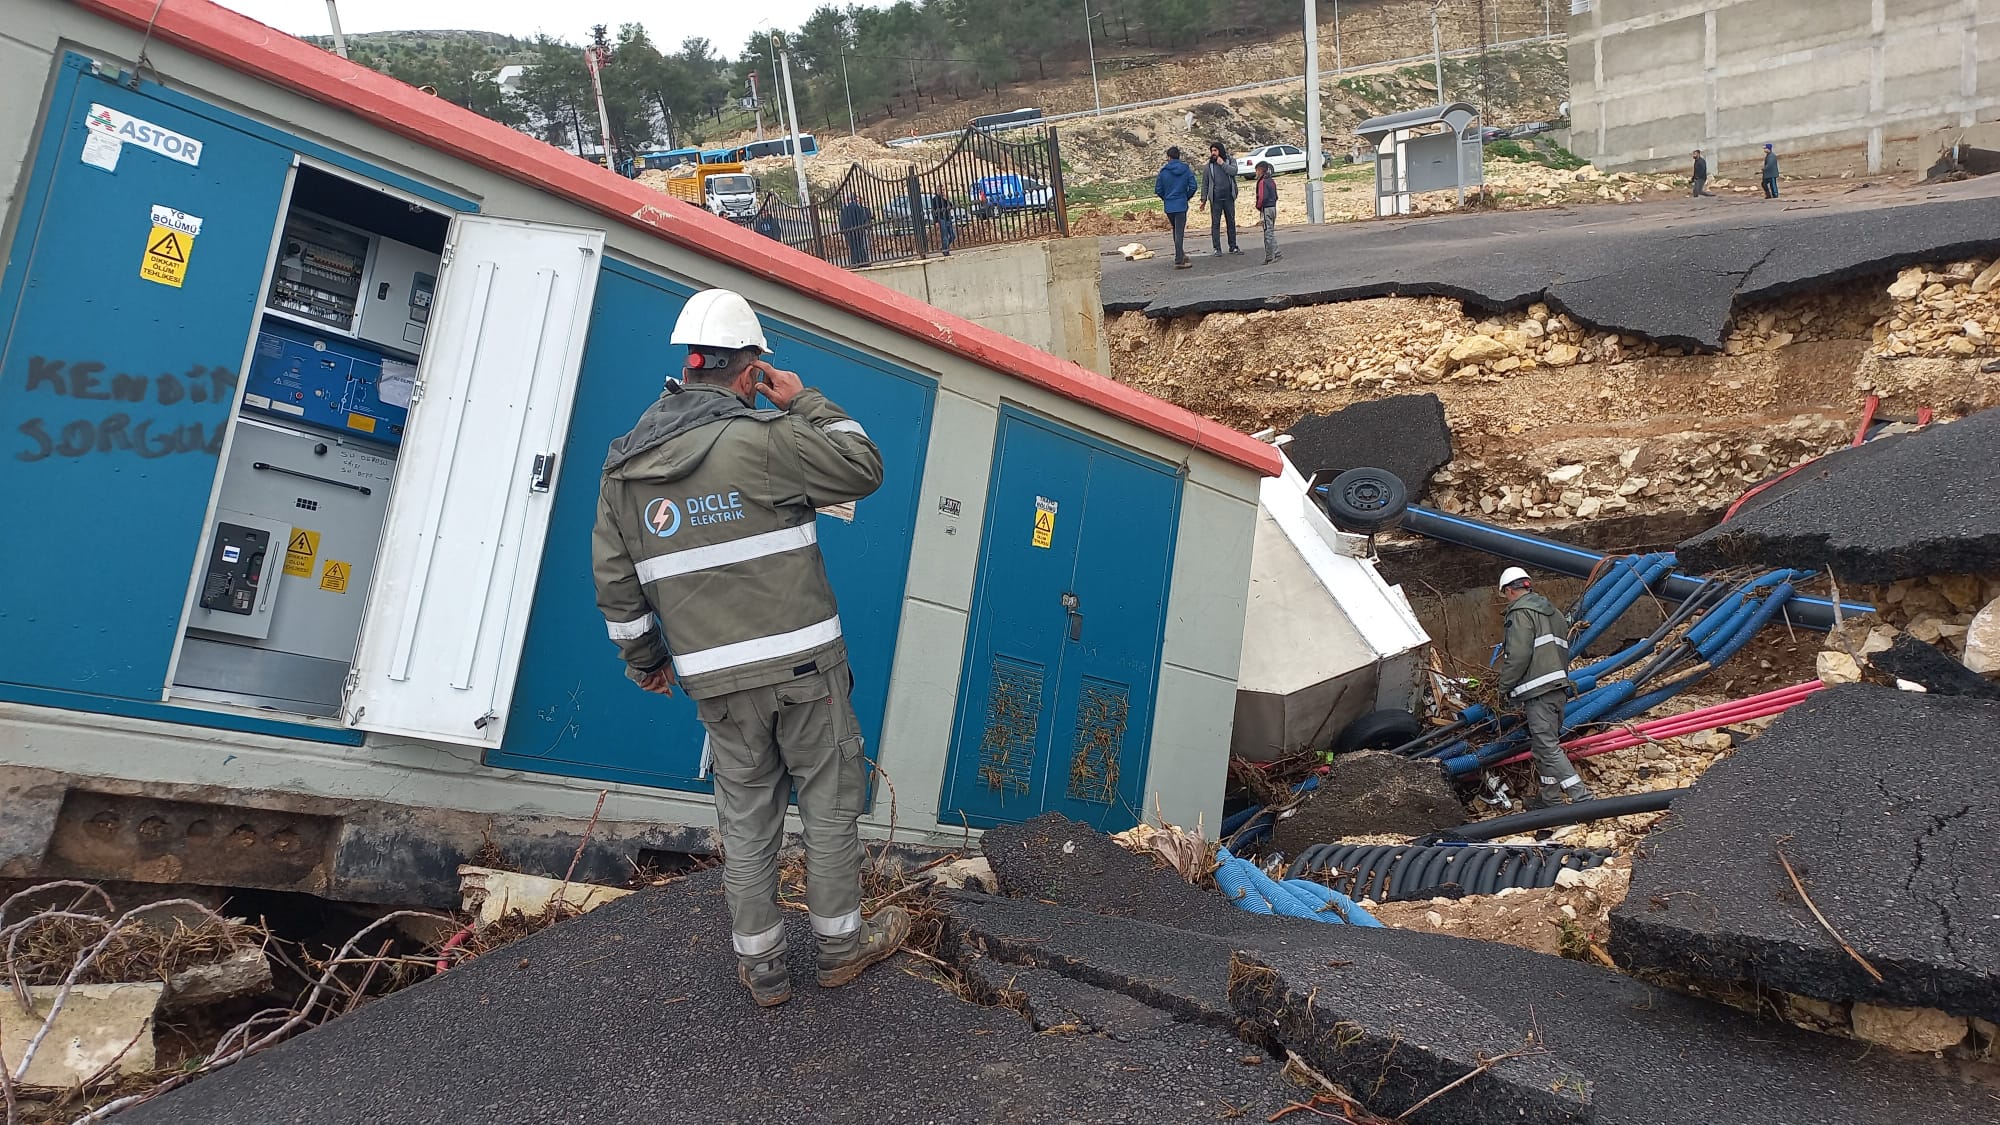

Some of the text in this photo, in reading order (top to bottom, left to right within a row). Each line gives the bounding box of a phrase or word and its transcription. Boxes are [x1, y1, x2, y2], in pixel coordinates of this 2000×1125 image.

[119, 120, 197, 161] ASTOR
[153, 213, 197, 234] BÖLÜMÜ
[170, 209, 185, 220] YG
[690, 509, 746, 527] ELEKTRIK
